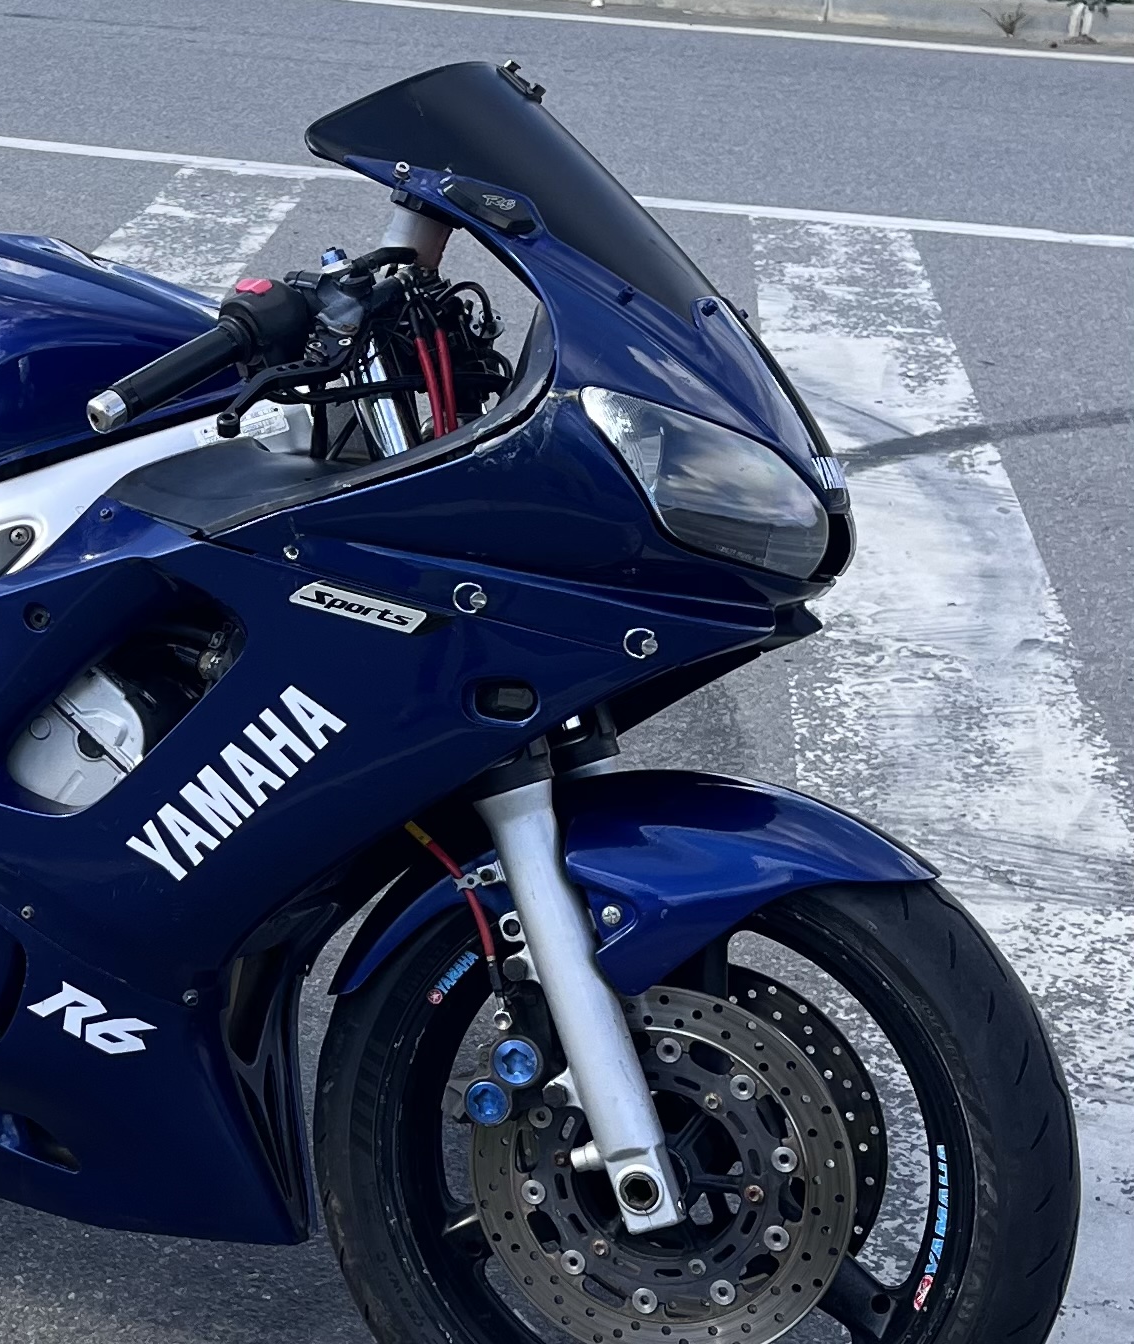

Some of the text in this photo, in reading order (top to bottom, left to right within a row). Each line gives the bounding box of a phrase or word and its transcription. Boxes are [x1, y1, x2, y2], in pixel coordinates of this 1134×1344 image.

[299, 590, 414, 626] Sports
[125, 684, 348, 882] YAMAHA
[434, 950, 479, 995] YAMAHA
[26, 980, 158, 1055] R6
